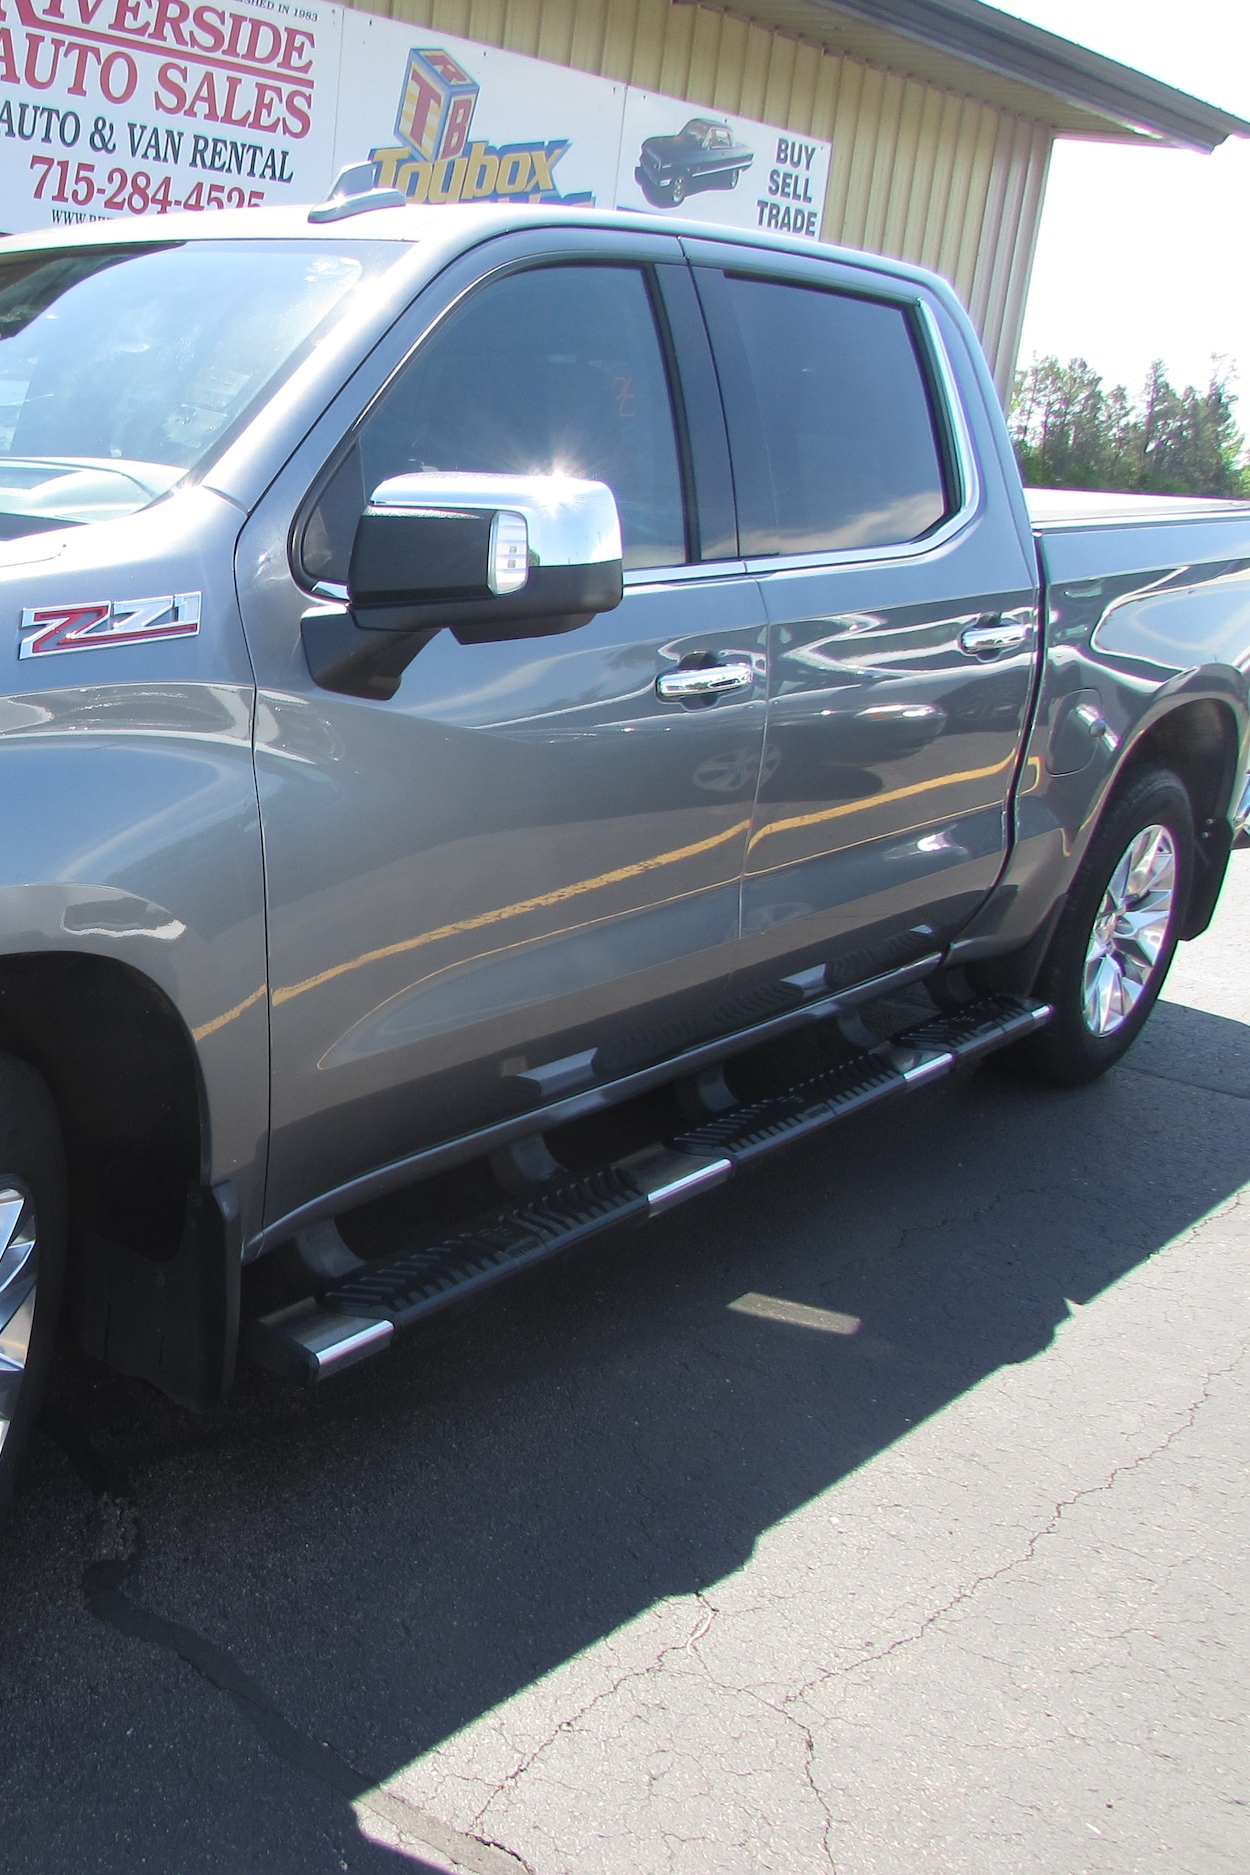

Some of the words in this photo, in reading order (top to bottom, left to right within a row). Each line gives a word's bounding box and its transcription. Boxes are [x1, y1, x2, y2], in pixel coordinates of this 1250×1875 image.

[278, 3, 290, 15] IN
[293, 8, 318, 22] 1983
[154, 62, 312, 139] SALES
[89, 116, 116, 154] &
[127, 123, 184, 165] VAN
[189, 134, 294, 184] RENTAL
[372, 142, 563, 204] Toybox
[775, 137, 816, 171] BUY
[768, 169, 812, 204] SELL
[756, 199, 817, 237] TRADE
[18, 591, 201, 660] Z71
